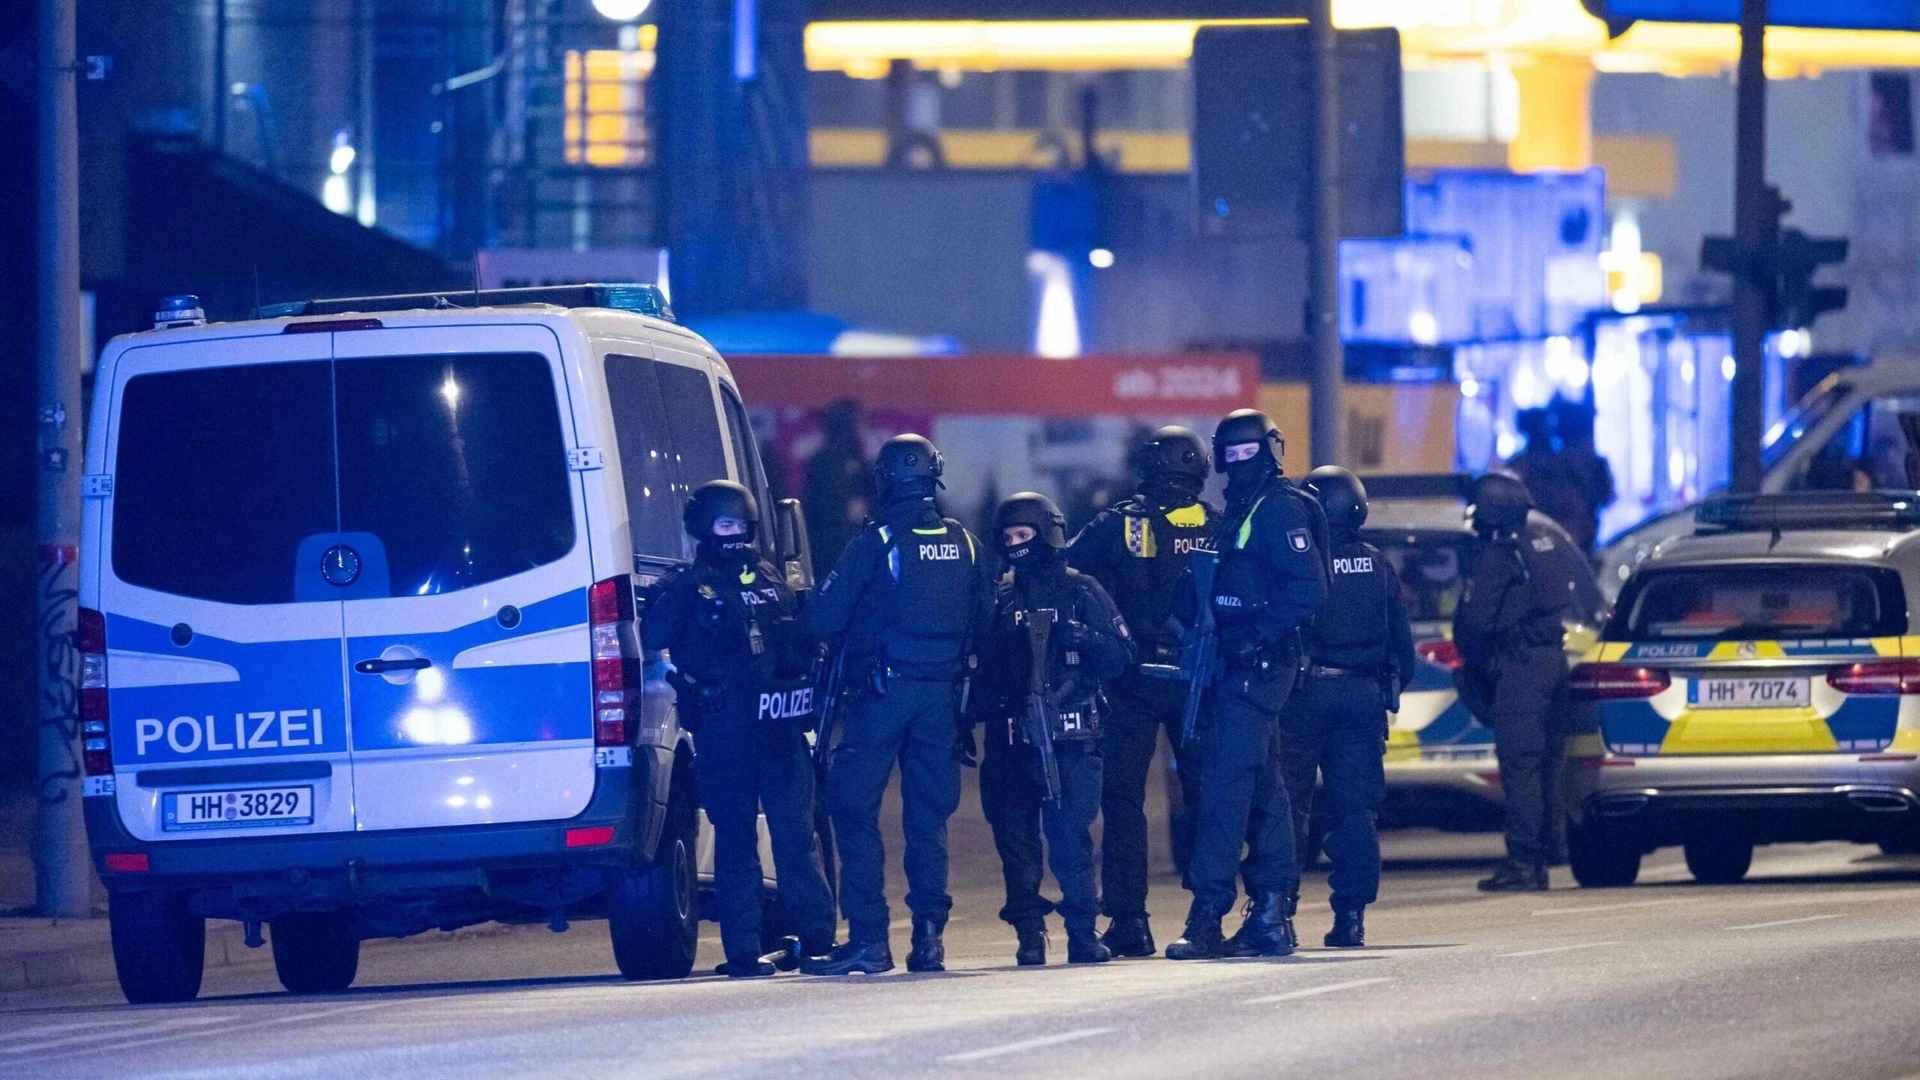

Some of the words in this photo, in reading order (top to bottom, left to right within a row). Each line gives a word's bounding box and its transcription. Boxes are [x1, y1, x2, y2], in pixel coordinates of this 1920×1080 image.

[919, 544, 960, 560] POLIZEI
[1333, 557, 1373, 574] POLIZEI
[1637, 643, 1699, 658] POLIZEI
[1709, 682, 1735, 701] HH
[1749, 681, 1798, 701] 7074
[136, 708, 323, 756] POLIZEI
[191, 795, 223, 819] HH
[239, 792, 299, 817] 3829
